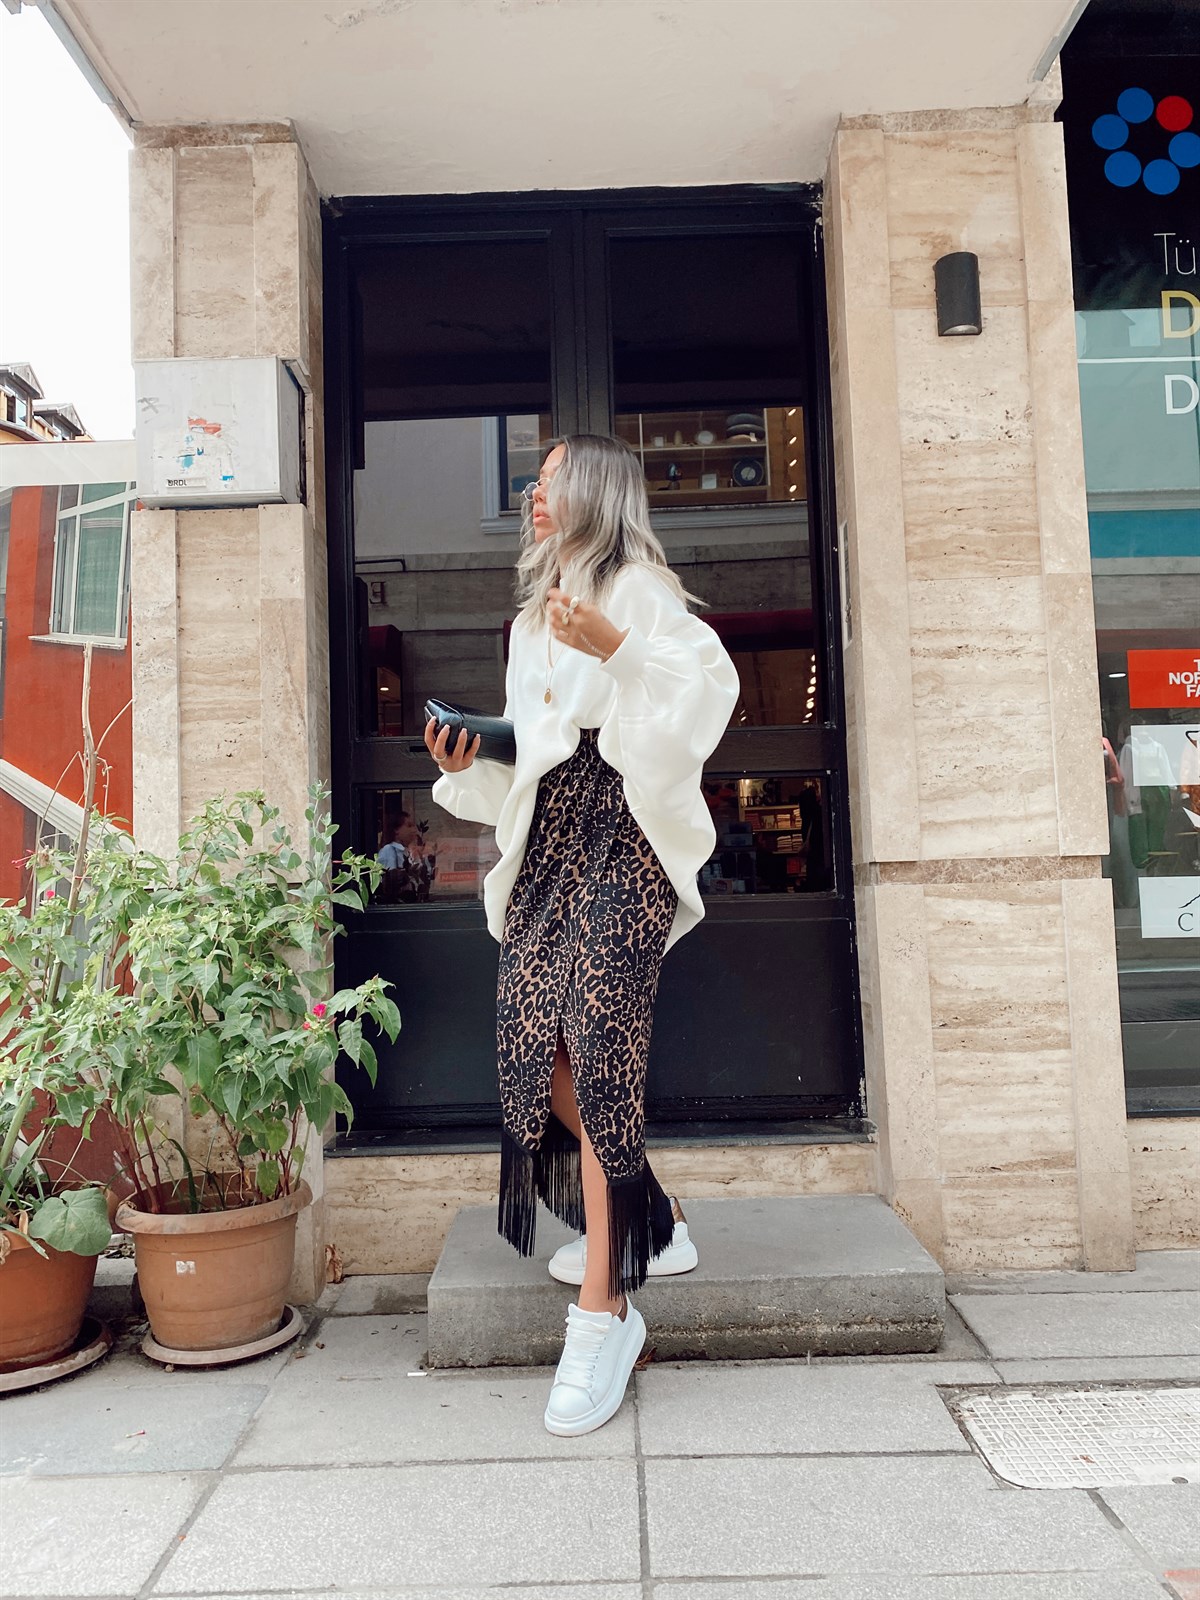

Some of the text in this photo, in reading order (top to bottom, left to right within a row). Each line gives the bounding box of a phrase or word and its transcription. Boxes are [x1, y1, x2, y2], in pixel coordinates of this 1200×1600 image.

[1153, 232, 1197, 275] Tü
[1161, 290, 1200, 339] D
[1164, 374, 1199, 414] D
